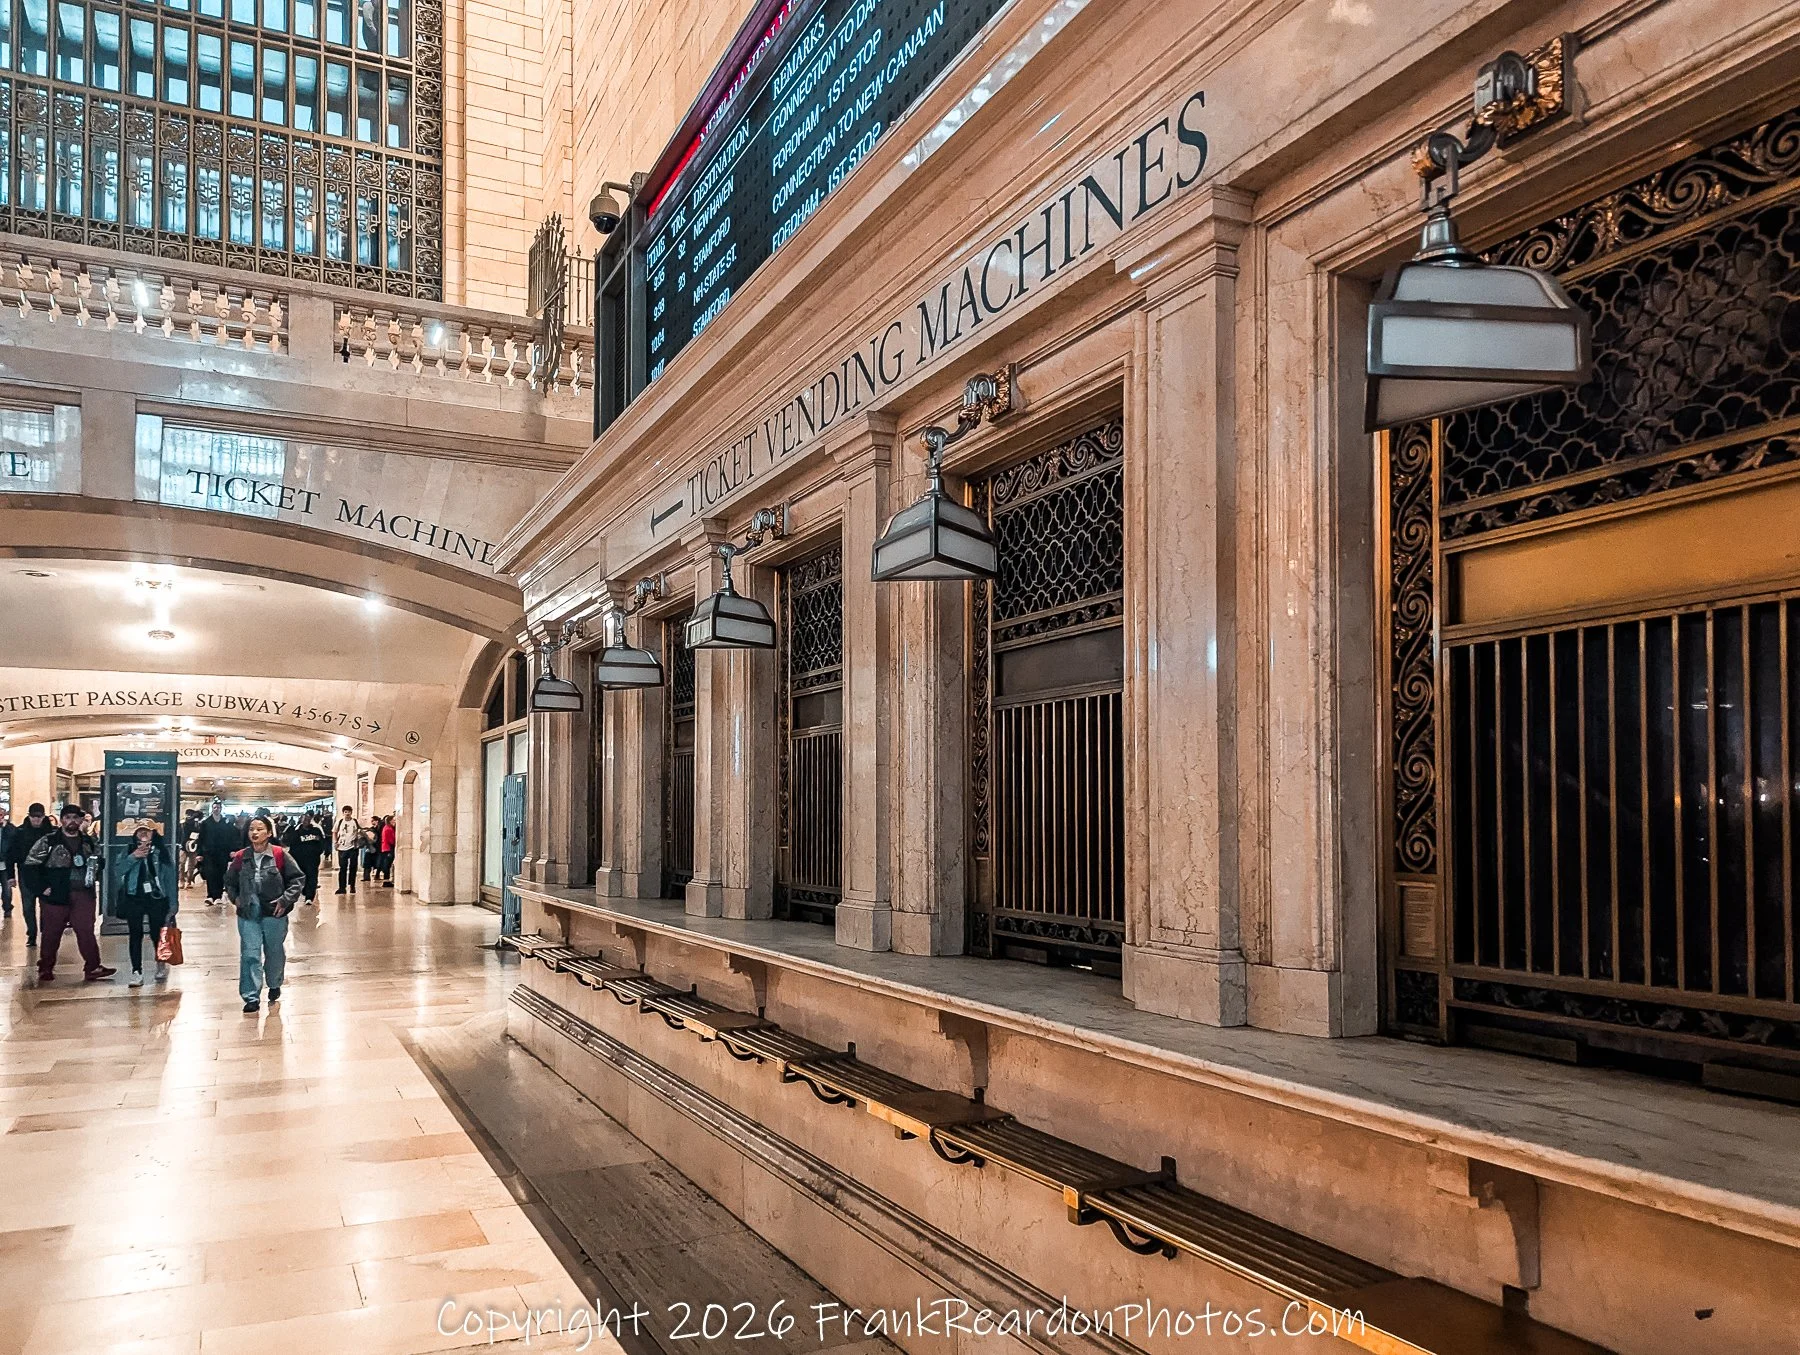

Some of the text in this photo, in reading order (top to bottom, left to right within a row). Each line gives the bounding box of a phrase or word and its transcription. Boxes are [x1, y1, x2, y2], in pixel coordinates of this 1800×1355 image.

[648, 14, 825, 268] TIME TRK DESTINATION REMARKS
[693, 208, 709, 240] NEW
[709, 175, 734, 221] HAVEN
[773, 38, 837, 137] CONNECTION
[838, 18, 854, 50] TO
[693, 216, 731, 273] STAMFORD
[773, 103, 820, 177] FORDHAM
[828, 68, 848, 108] 1ST
[849, 28, 882, 83] STOP
[773, 126, 837, 214] CONNECTION
[838, 108, 854, 139] TO
[855, 69, 884, 121] NEW
[886, 0, 944, 84] CANAAN
[687, 90, 1208, 518] TICKET VENDING MACHINES
[693, 287, 730, 338] STAMFORD
[772, 192, 819, 253] FORDHAM
[828, 155, 847, 190] 1ST
[849, 121, 881, 173] STOP
[187, 469, 321, 516] TICKET
[86, 690, 183, 707] PASSAGE
[195, 693, 287, 716] SUBWAY
[224, 748, 275, 761] PASSAGE
